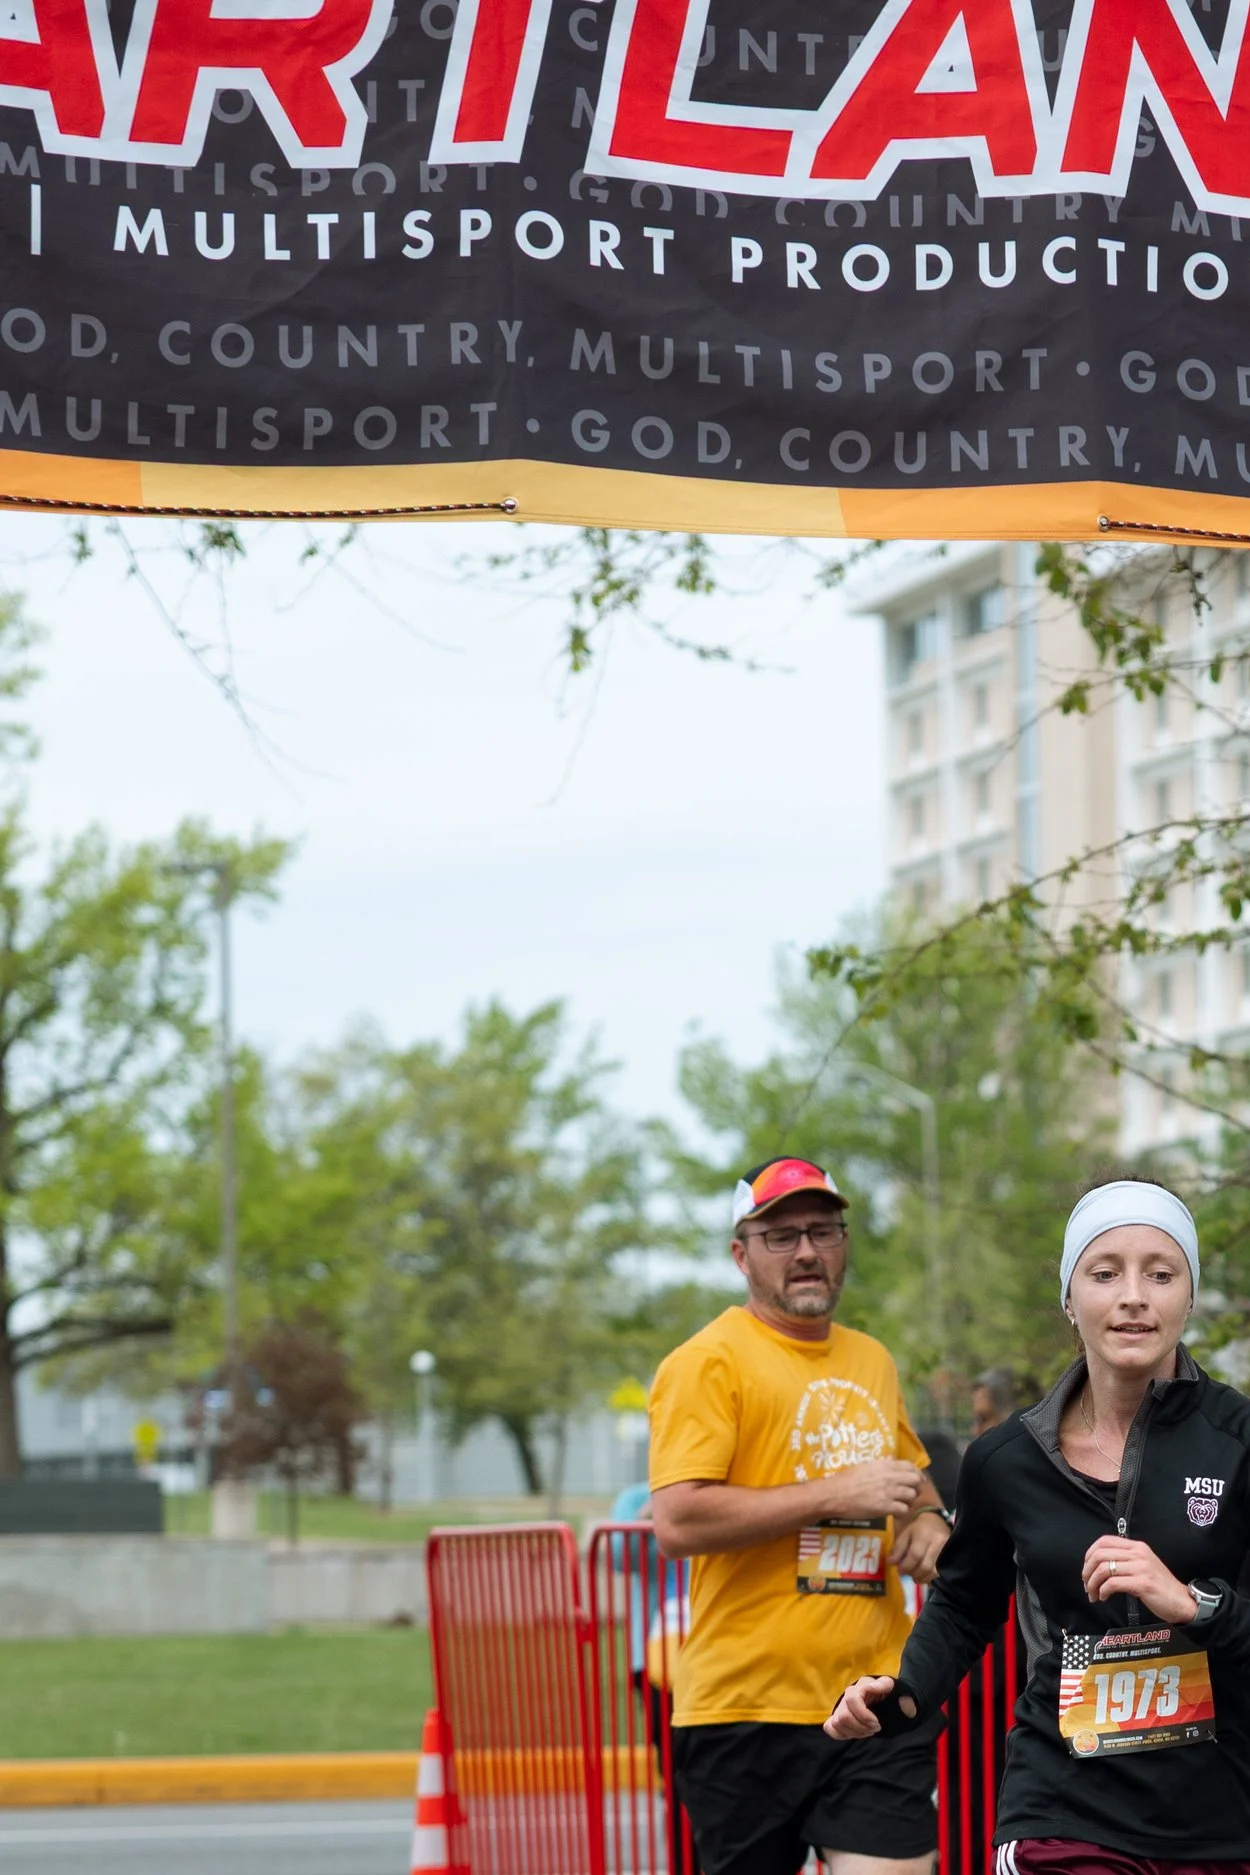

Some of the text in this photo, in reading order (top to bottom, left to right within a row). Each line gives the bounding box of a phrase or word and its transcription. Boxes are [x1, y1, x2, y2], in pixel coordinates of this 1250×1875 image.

[113, 205, 675, 276] MULTISPORT
[158, 319, 536, 368] COUNTRY,
[570, 328, 1047, 394] MULTISPORT
[0, 390, 497, 450] MULTISPORT
[571, 410, 744, 470] GOD,
[780, 425, 1141, 473] COUNTRY,
[1184, 1477, 1226, 1497] MSU
[1099, 1629, 1171, 1646] HEARTLAND
[1094, 1665, 1182, 1725] 1973
